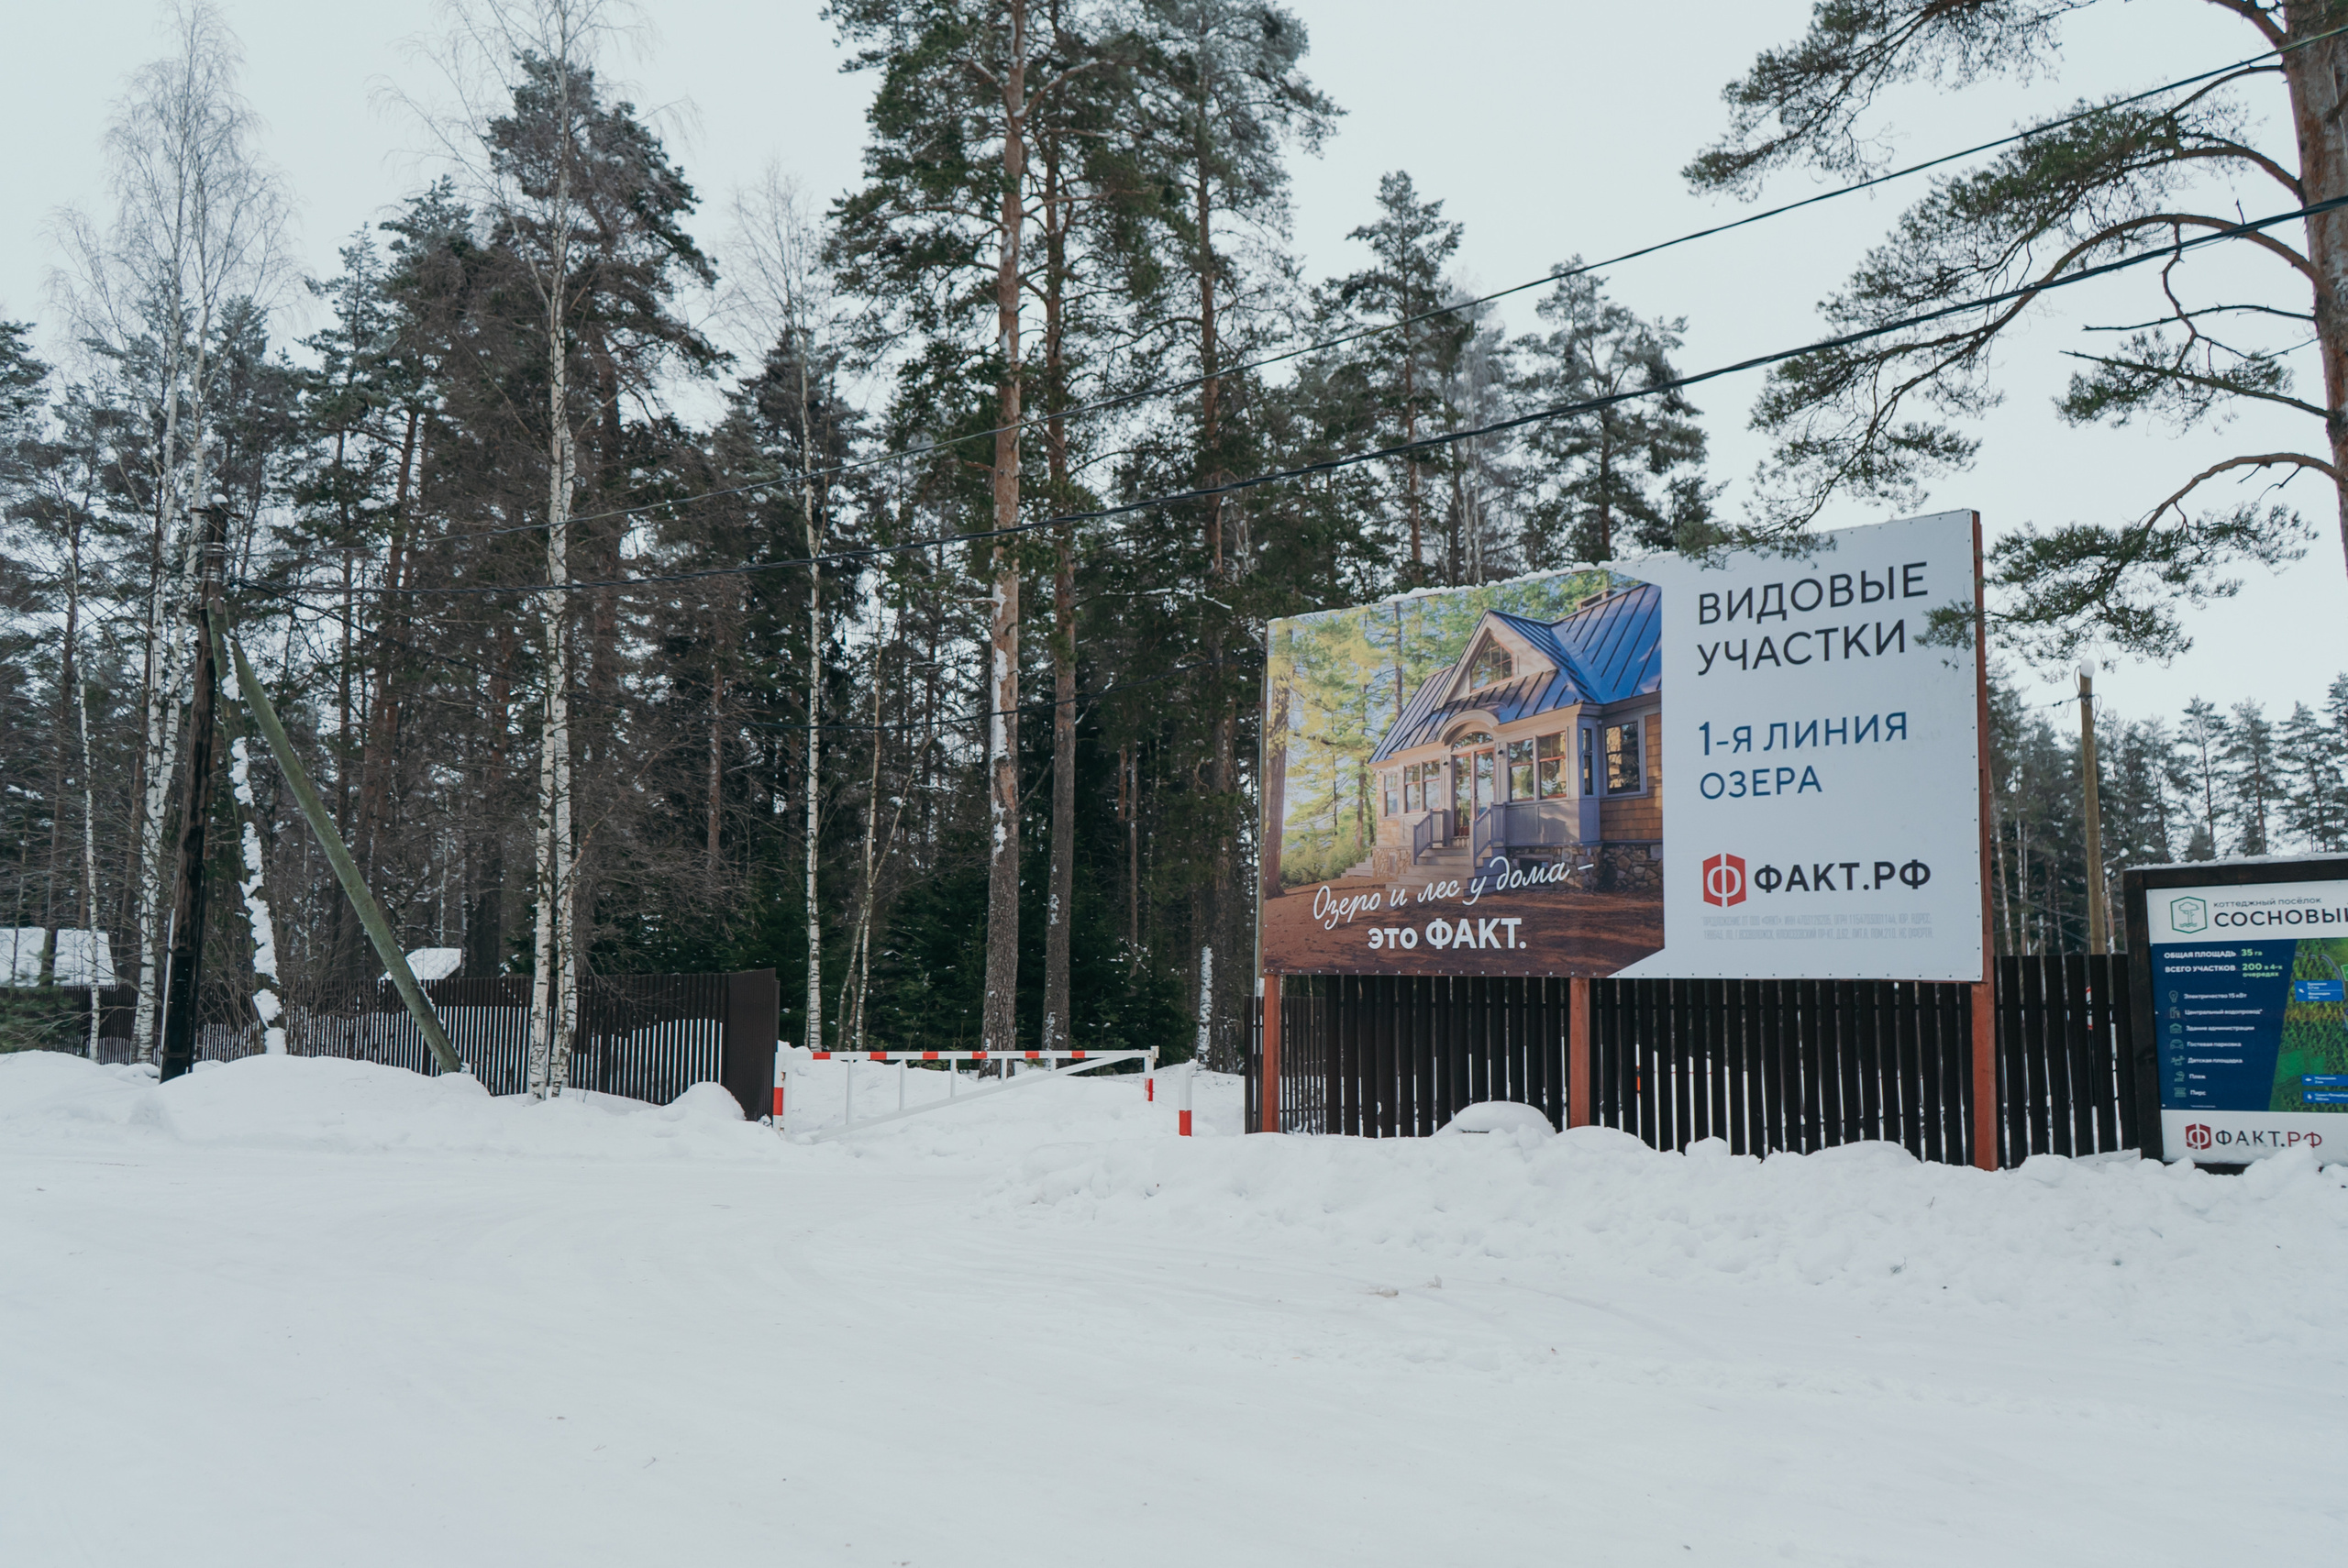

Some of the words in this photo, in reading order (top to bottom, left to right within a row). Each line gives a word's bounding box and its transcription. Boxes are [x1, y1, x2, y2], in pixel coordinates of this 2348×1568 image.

[1699, 561, 1928, 624] ВИДОВЫЕ
[1697, 619, 1905, 676] УЧАСТКИ
[1699, 722, 1752, 756] 1-Я
[1763, 712, 1908, 751] ЛИНИЯ
[1700, 765, 1823, 800] ОЗЕРА
[1754, 859, 1931, 893] ФАКТ.РФ
[1312, 885, 1381, 931] Озеро
[1390, 888, 1408, 909] и
[1417, 878, 1460, 904] лес
[1462, 875, 1487, 906] у
[1489, 856, 1571, 891] дома
[2213, 899, 2276, 908] коттеджный
[2278, 897, 2321, 905] посёлок
[1368, 928, 1418, 949] это
[1424, 918, 1527, 950] ФАКТ.
[2214, 908, 2348, 927] СОСНОВЫ
[2195, 950, 2237, 958] ПЛОЩАДЬ
[2241, 948, 2254, 956] 35
[2242, 963, 2263, 971] 200
[2215, 1130, 2322, 1148] ФАКТ.РФ
